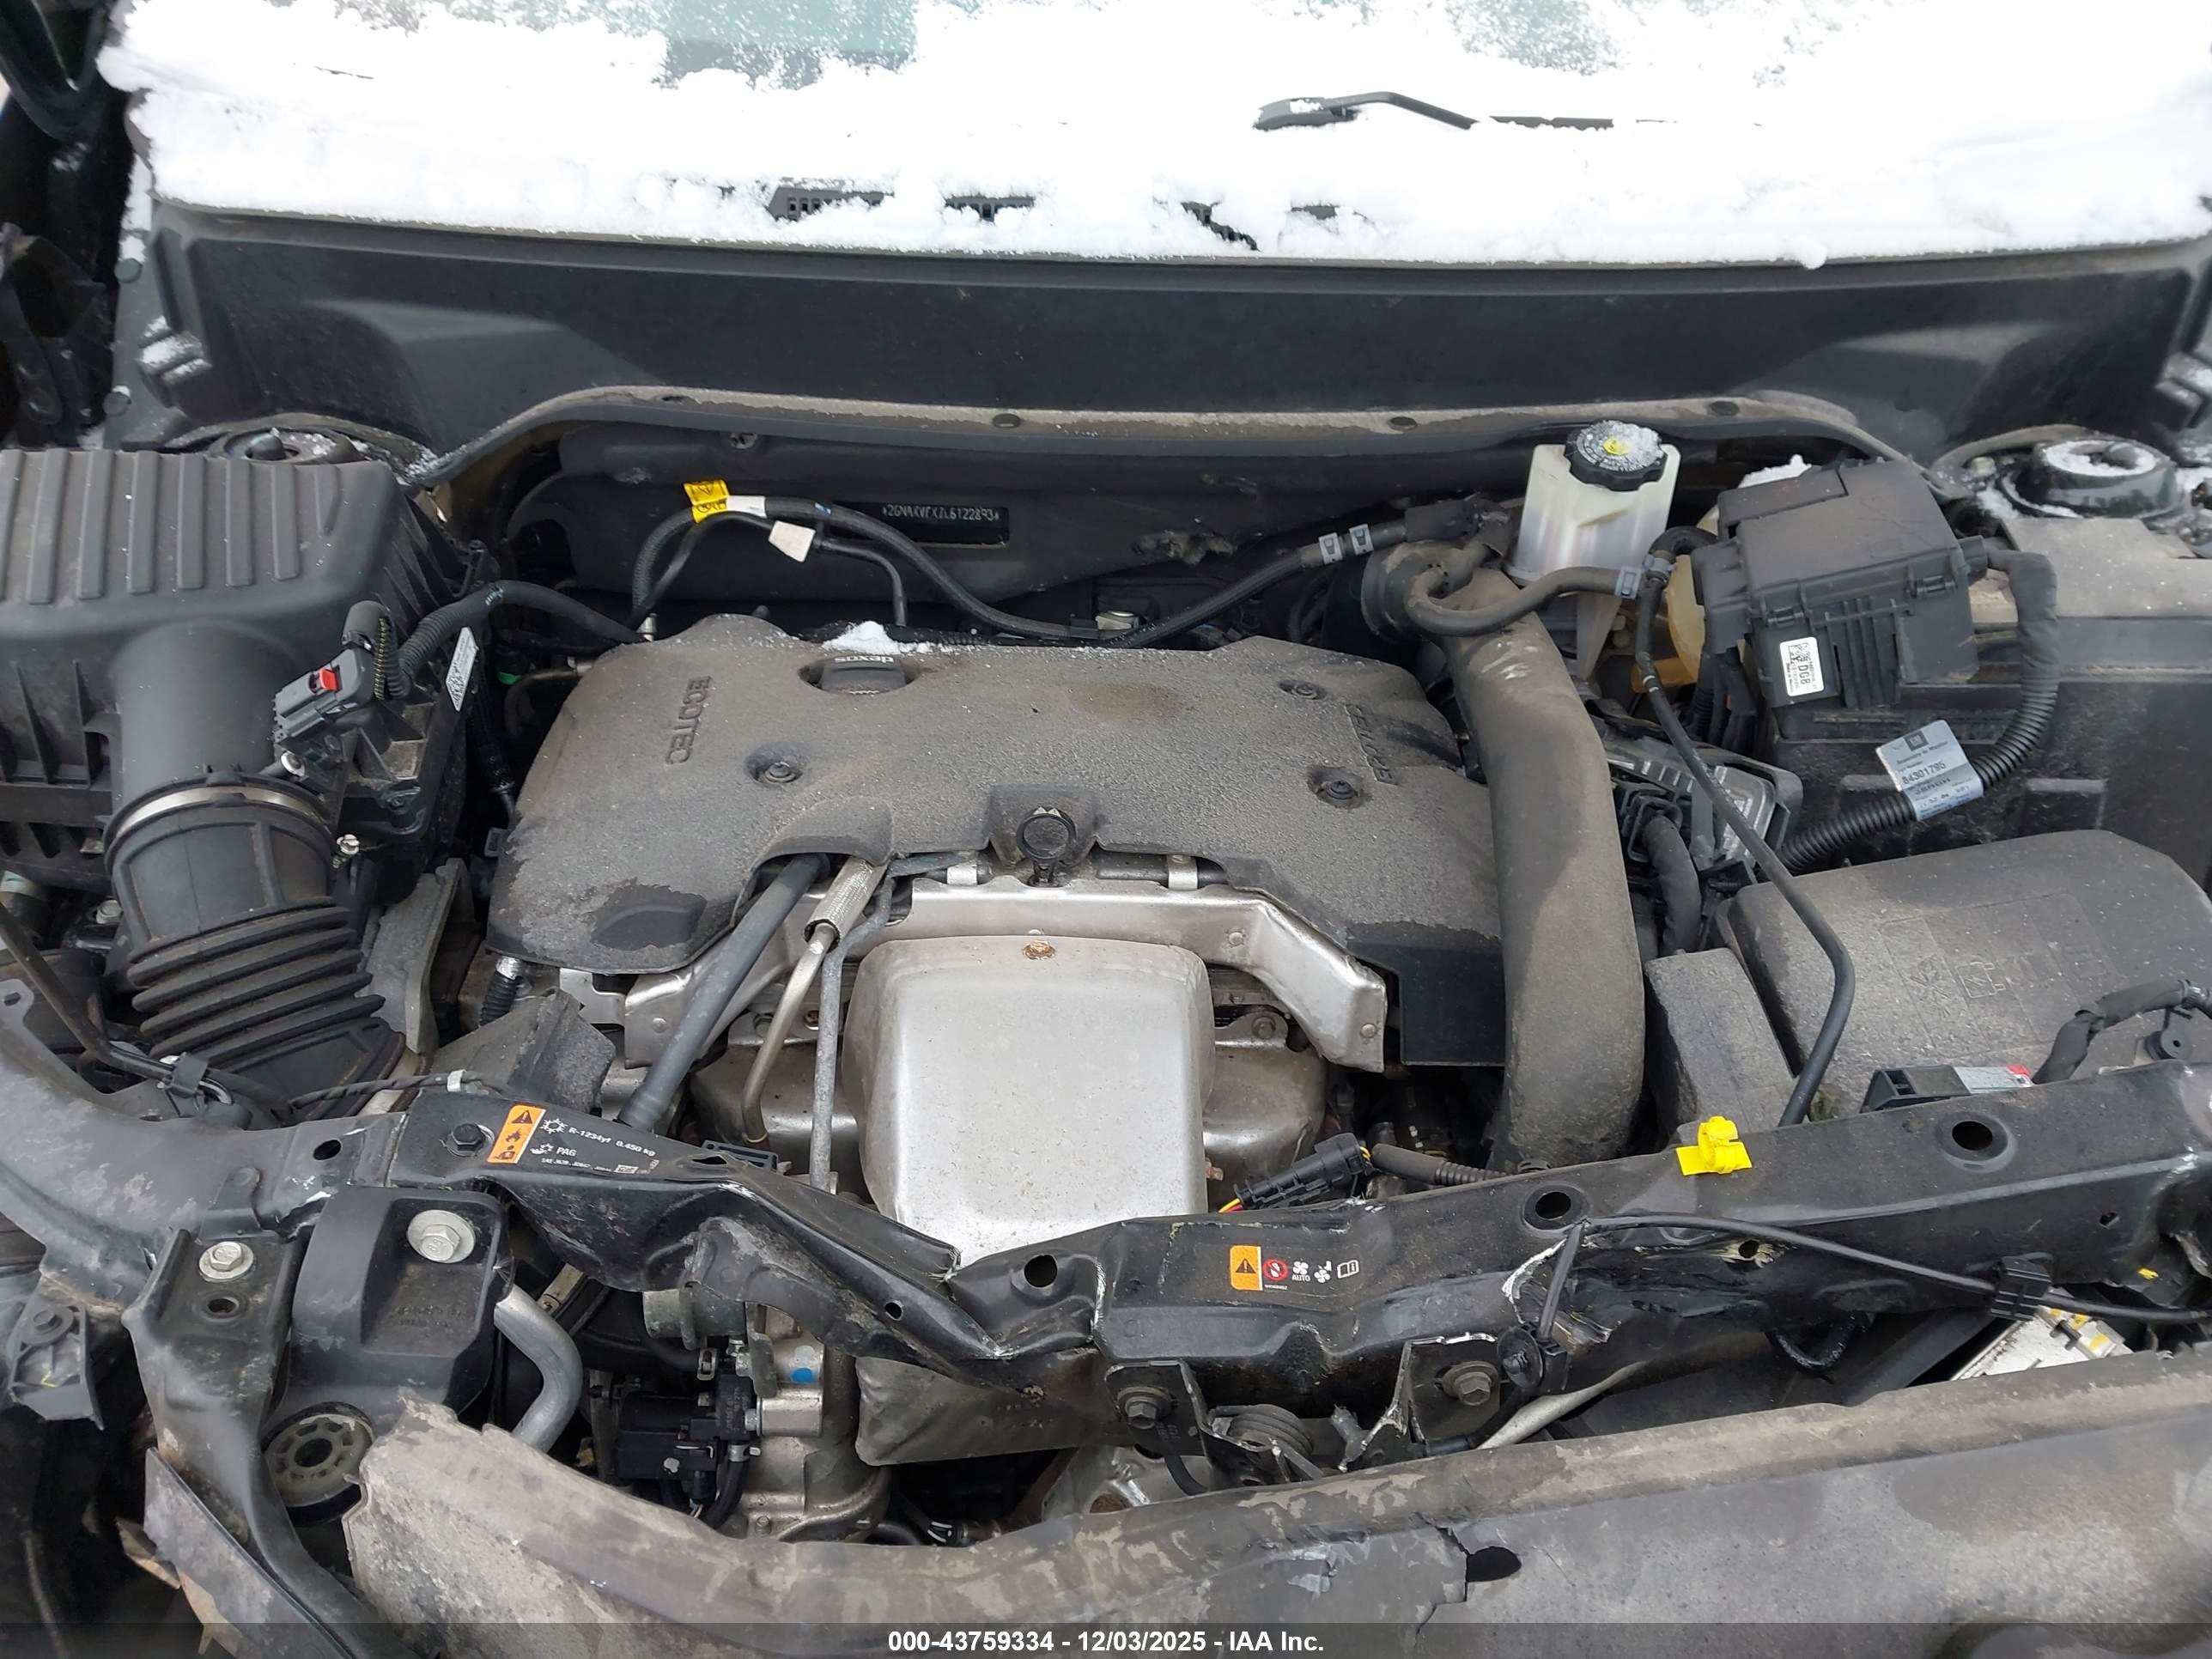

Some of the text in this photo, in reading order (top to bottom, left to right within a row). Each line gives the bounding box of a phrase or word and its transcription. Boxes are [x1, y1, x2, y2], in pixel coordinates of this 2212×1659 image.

[665, 675, 712, 765] ECOTEC
[1902, 761, 1947, 785] 84301795
[556, 1146, 577, 1158] PAG
[568, 1127, 612, 1144] R-1234yf
[642, 1147, 656, 1158] kg
